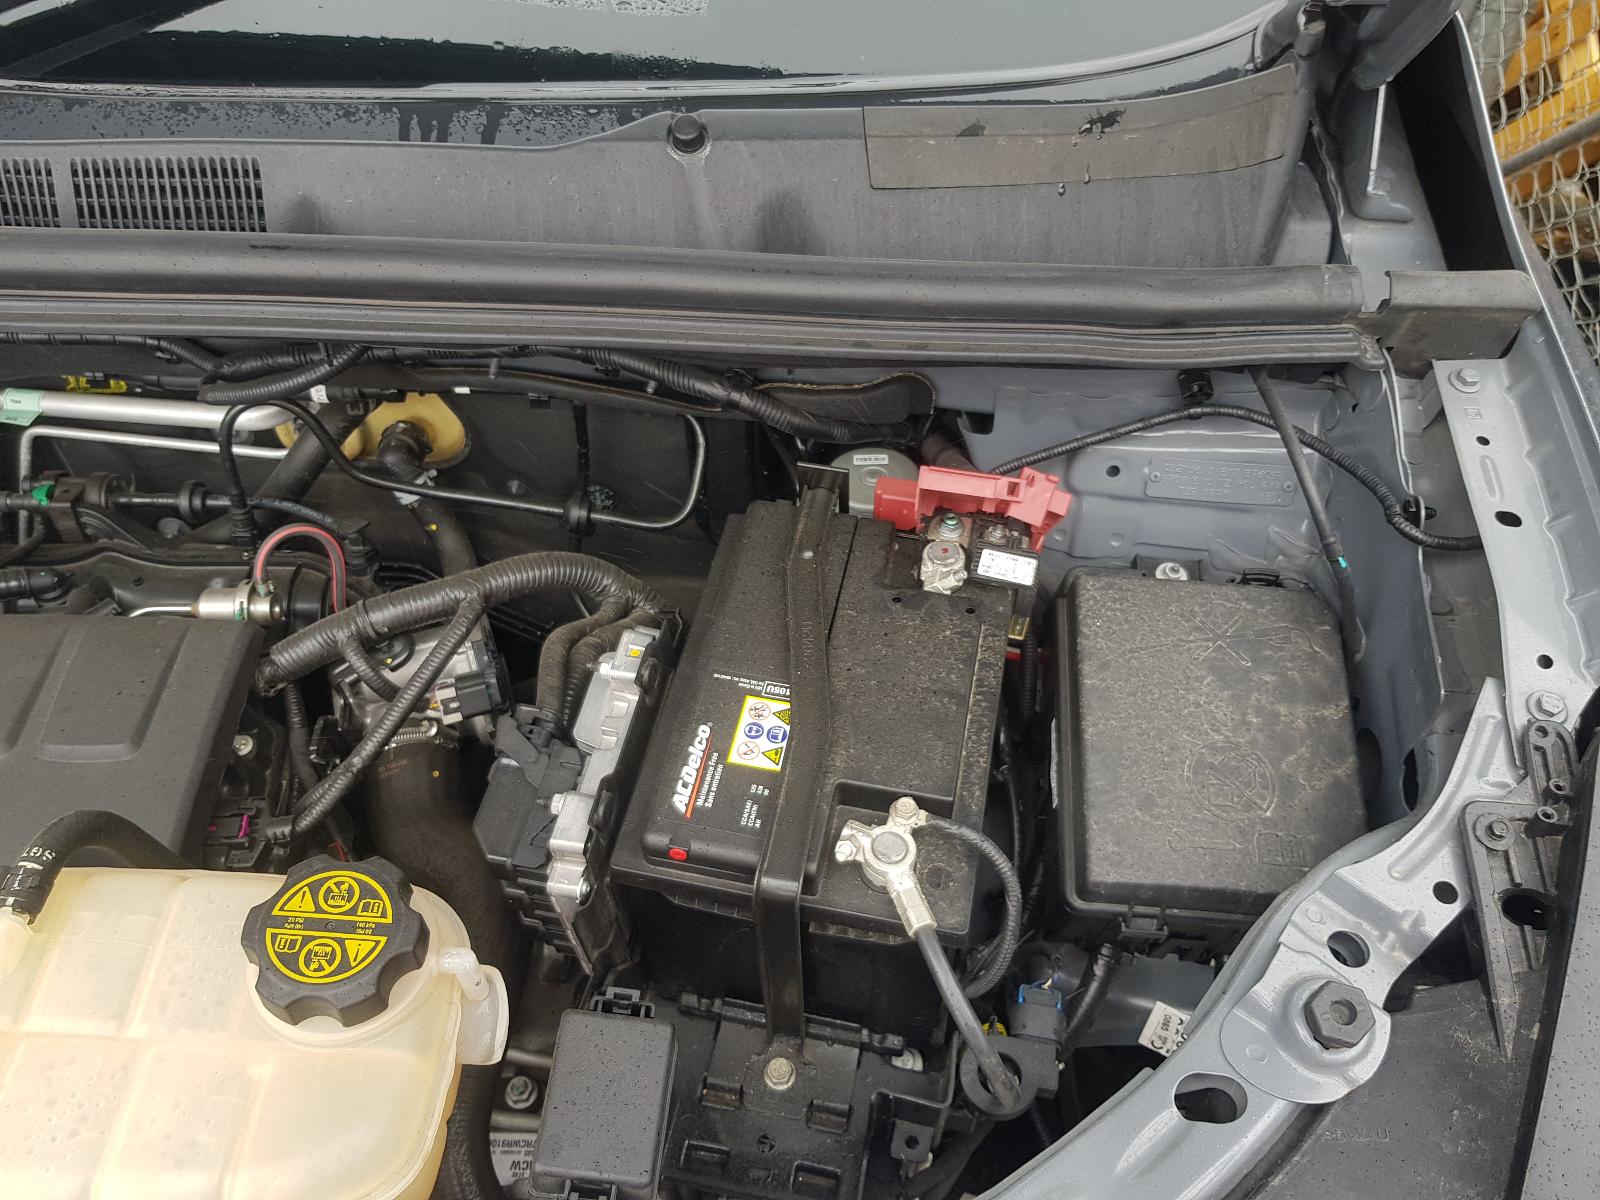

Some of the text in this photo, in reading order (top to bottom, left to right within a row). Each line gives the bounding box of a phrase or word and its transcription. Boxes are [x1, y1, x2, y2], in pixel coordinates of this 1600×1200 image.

[672, 724, 711, 814] ACDelco
[697, 752, 719, 806] Maintenance Free
[704, 764, 724, 808] Sans entretien
